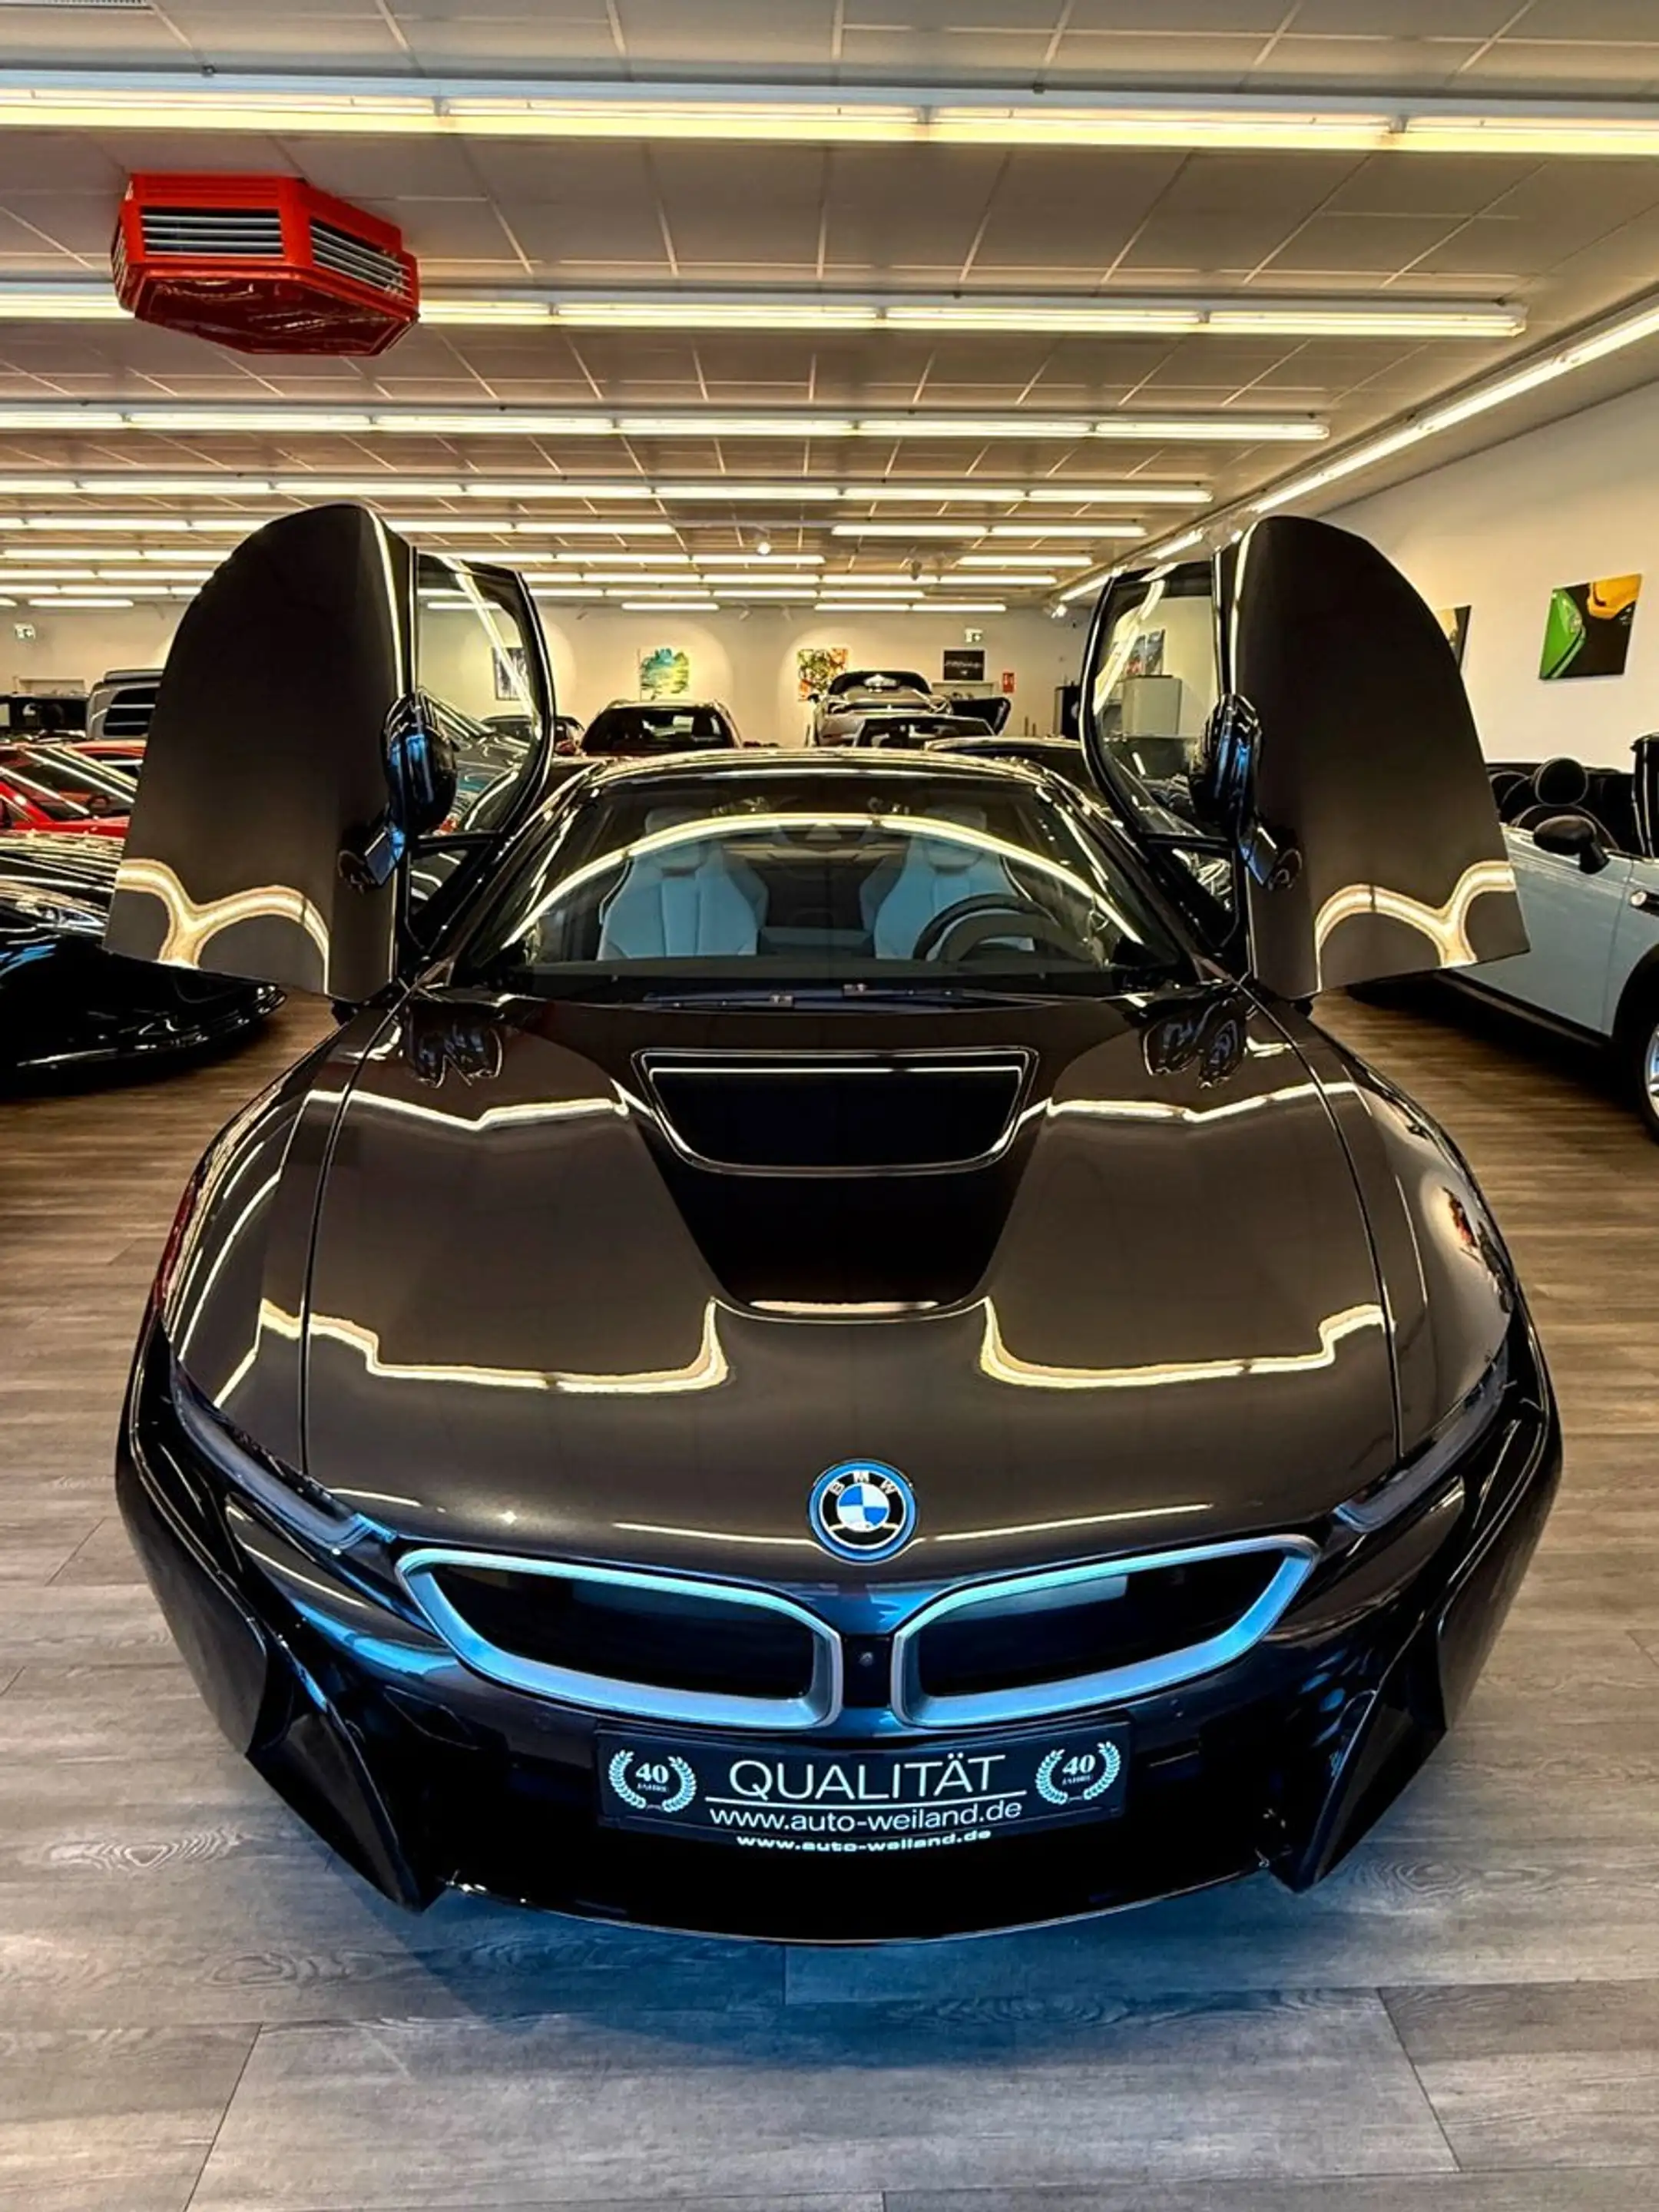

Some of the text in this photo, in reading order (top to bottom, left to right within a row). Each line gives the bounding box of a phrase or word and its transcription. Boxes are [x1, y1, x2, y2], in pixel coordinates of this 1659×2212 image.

[828, 1470, 898, 1496] BMW
[635, 1763, 669, 1783] 40
[729, 1752, 1005, 1800] QUALITÄT
[1061, 1754, 1096, 1776] 40
[710, 1800, 1022, 1831] www.auto-weiland.de
[736, 1830, 991, 1852] www.auto-weiland.de
